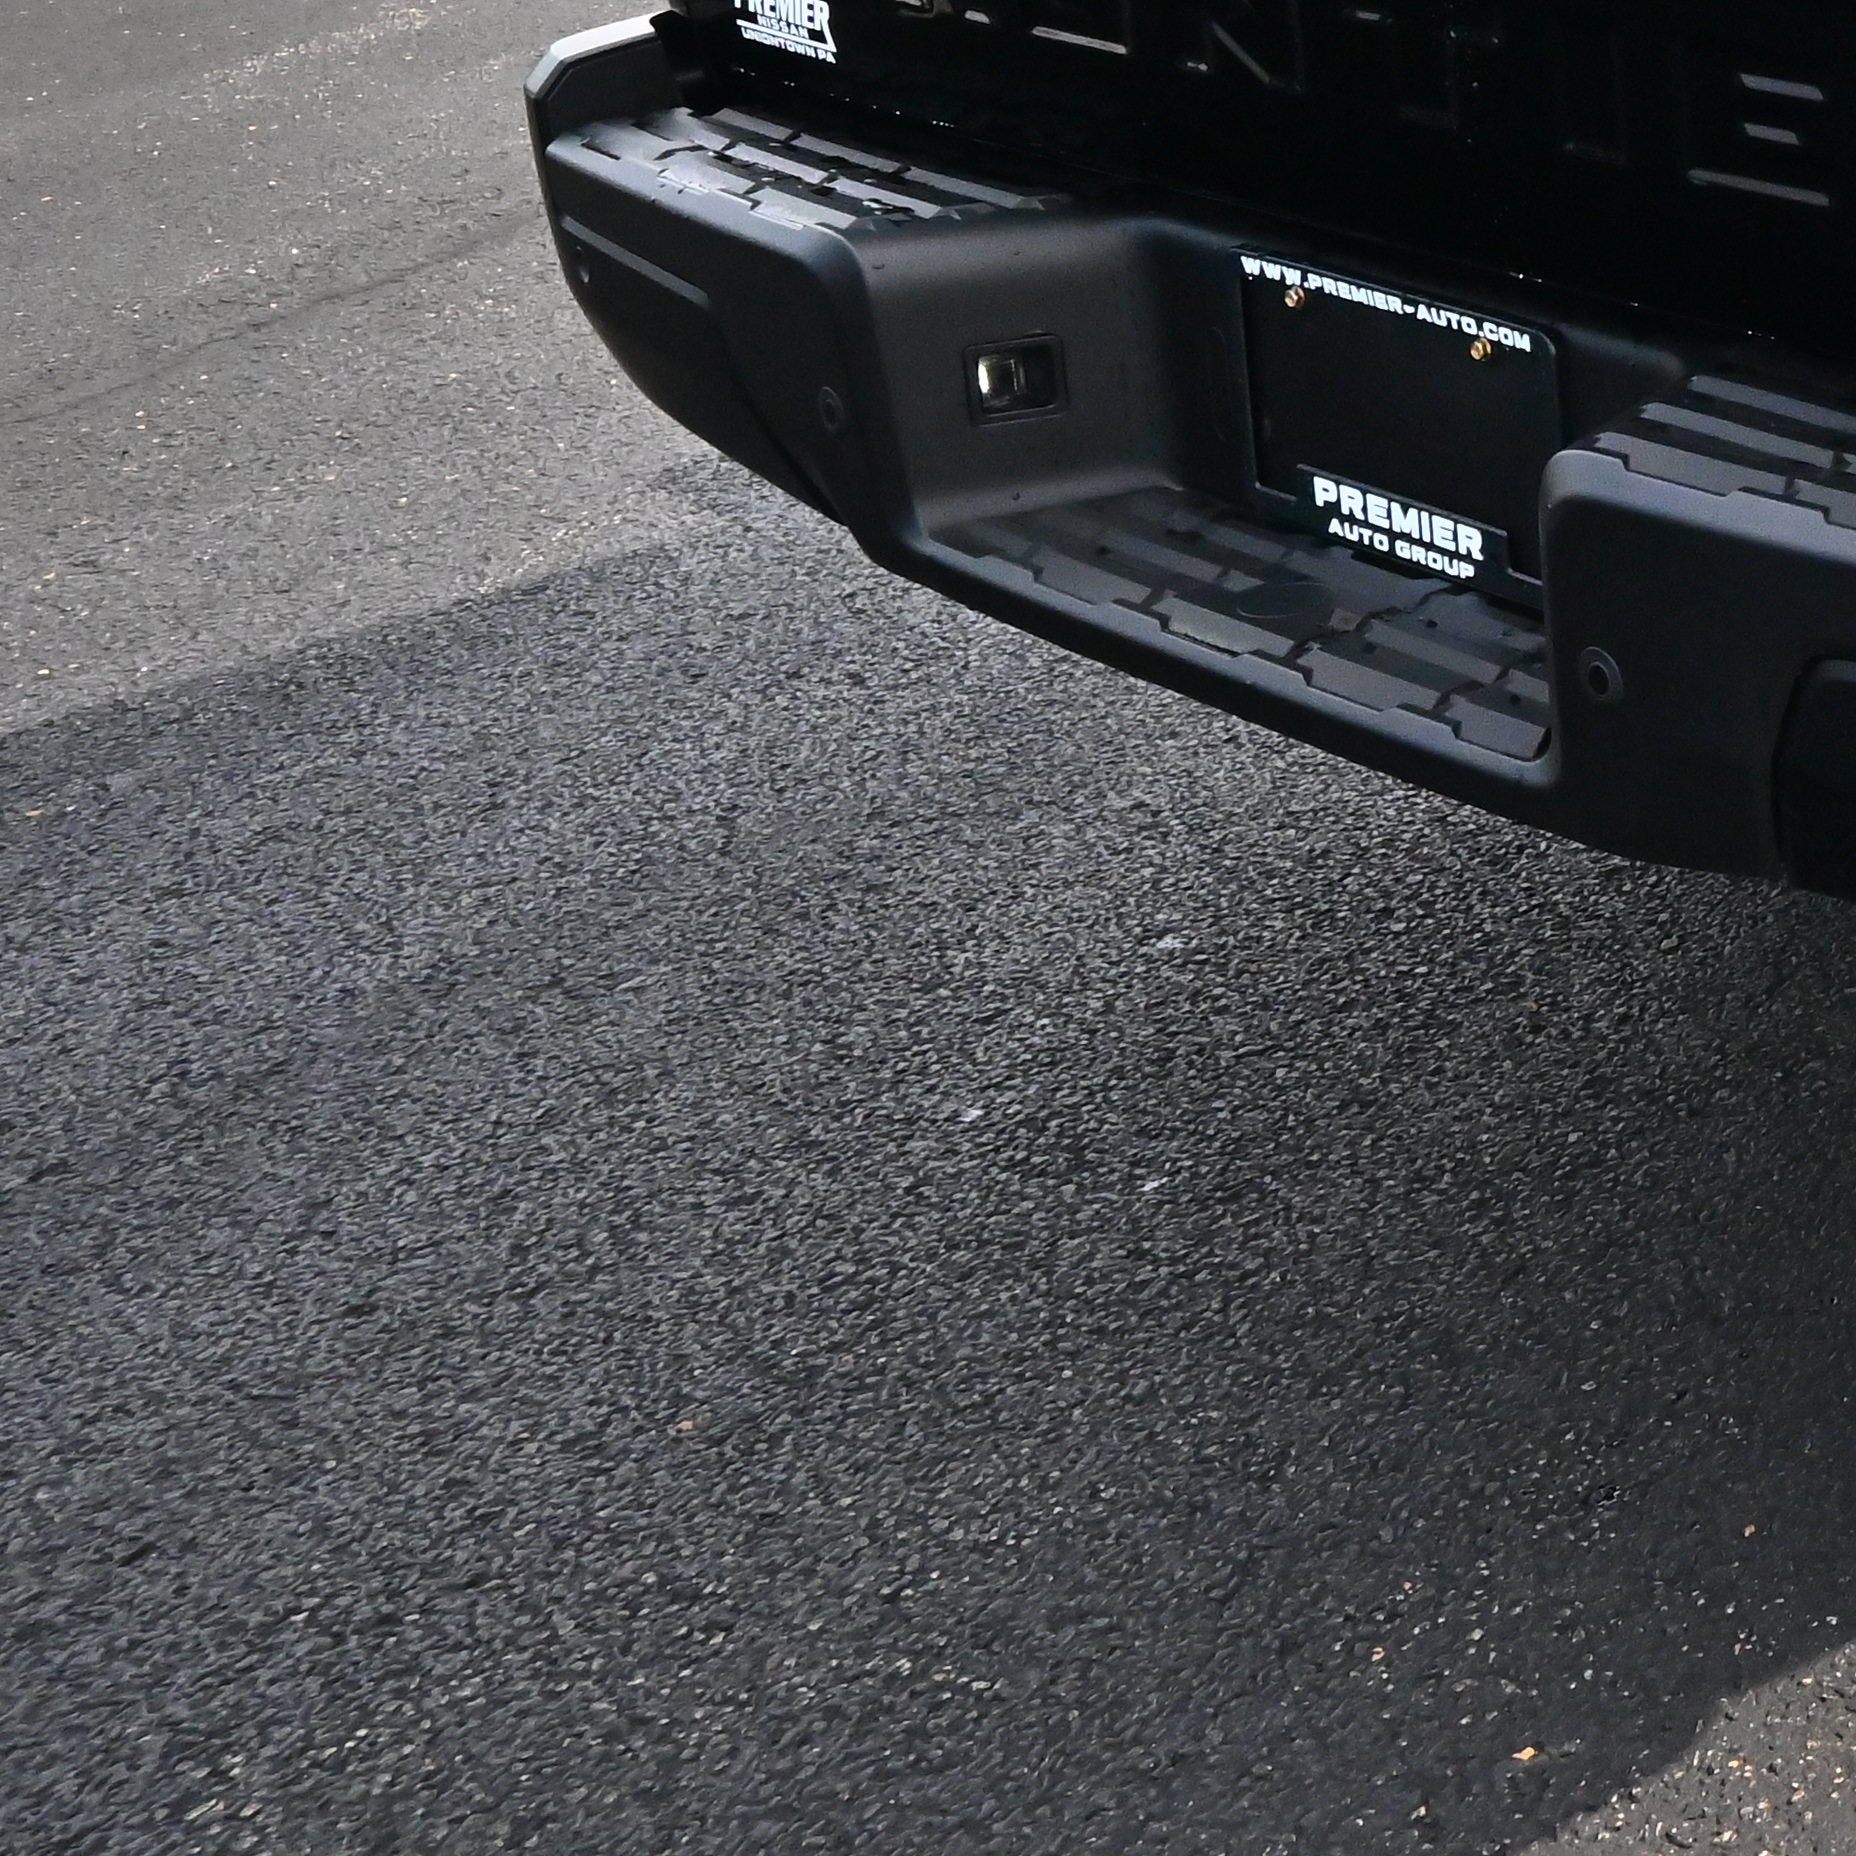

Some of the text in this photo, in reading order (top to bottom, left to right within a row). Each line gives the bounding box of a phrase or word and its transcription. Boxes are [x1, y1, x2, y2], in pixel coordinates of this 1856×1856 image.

[756, 13, 810, 40] NISSAN
[816, 48, 837, 65] PA
[1240, 254, 1532, 353] WWW.PREMIER-AUTO.COM
[1312, 475, 1484, 561] PREMIER
[1327, 517, 1475, 580] AUTO GROUP
